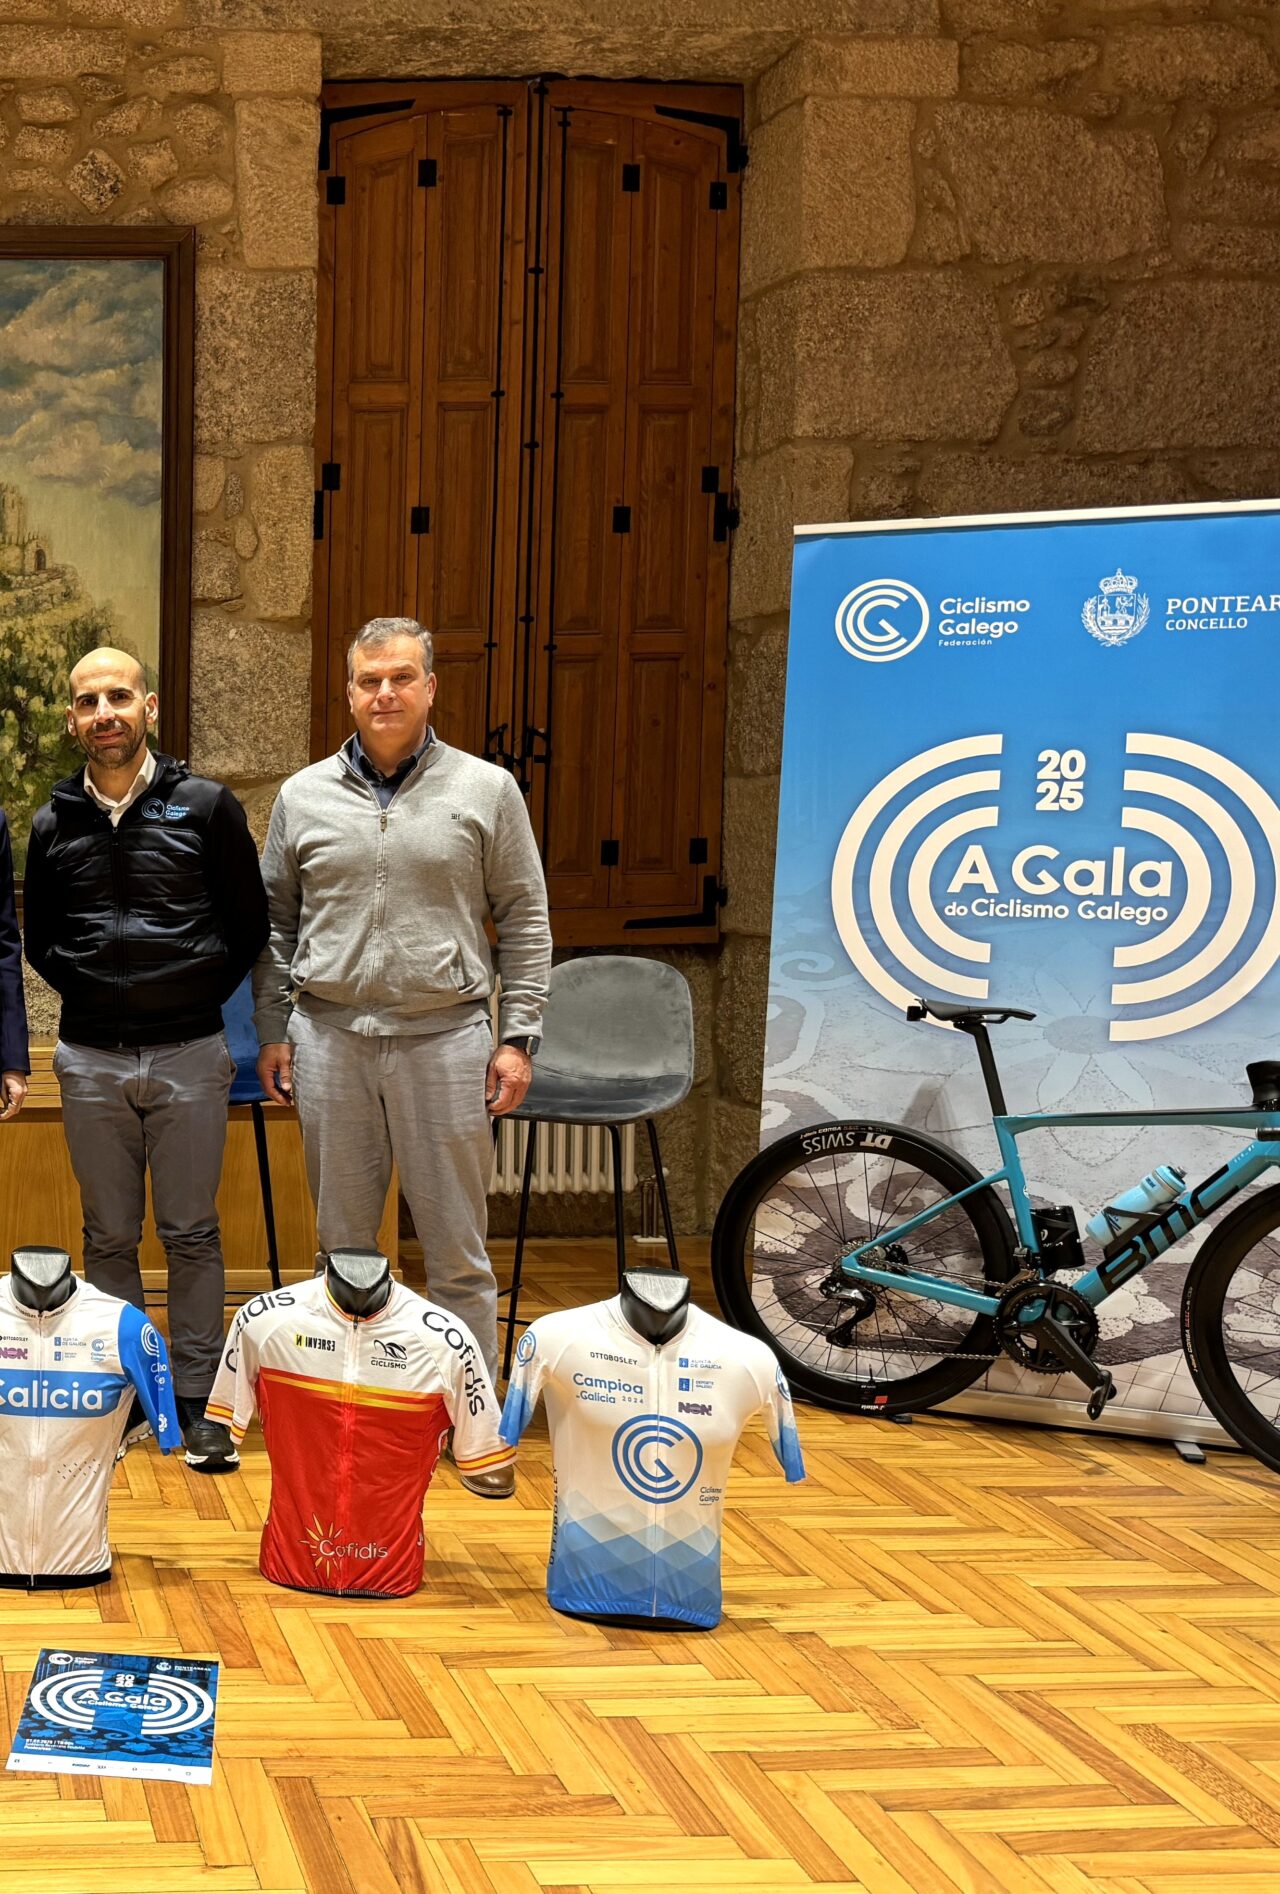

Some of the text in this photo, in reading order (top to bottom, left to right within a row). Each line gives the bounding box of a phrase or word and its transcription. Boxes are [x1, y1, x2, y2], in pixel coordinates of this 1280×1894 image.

[939, 596, 1031, 615] Ciclismo
[1166, 594, 1280, 615] PONTEAR
[938, 617, 1019, 639] Galego
[1165, 617, 1248, 631] CONCELLO
[1036, 749, 1086, 780] 20
[1035, 781, 1084, 812] 25
[946, 844, 1173, 897] A Gala
[944, 898, 1169, 926] do Ciclismo Galego
[802, 1131, 855, 1155] SWISS
[860, 1132, 893, 1149] DT
[1096, 1163, 1239, 1295] BMC
[370, 1359, 408, 1370] CICLISMO
[422, 1311, 486, 1416] Cofidis
[589, 1351, 638, 1366] OTTOBOSLEY
[573, 1372, 644, 1395] Campioa
[580, 1390, 616, 1404] Galicia
[319, 1540, 389, 1559] Cofidis
[78, 1690, 167, 1707] A Gala
